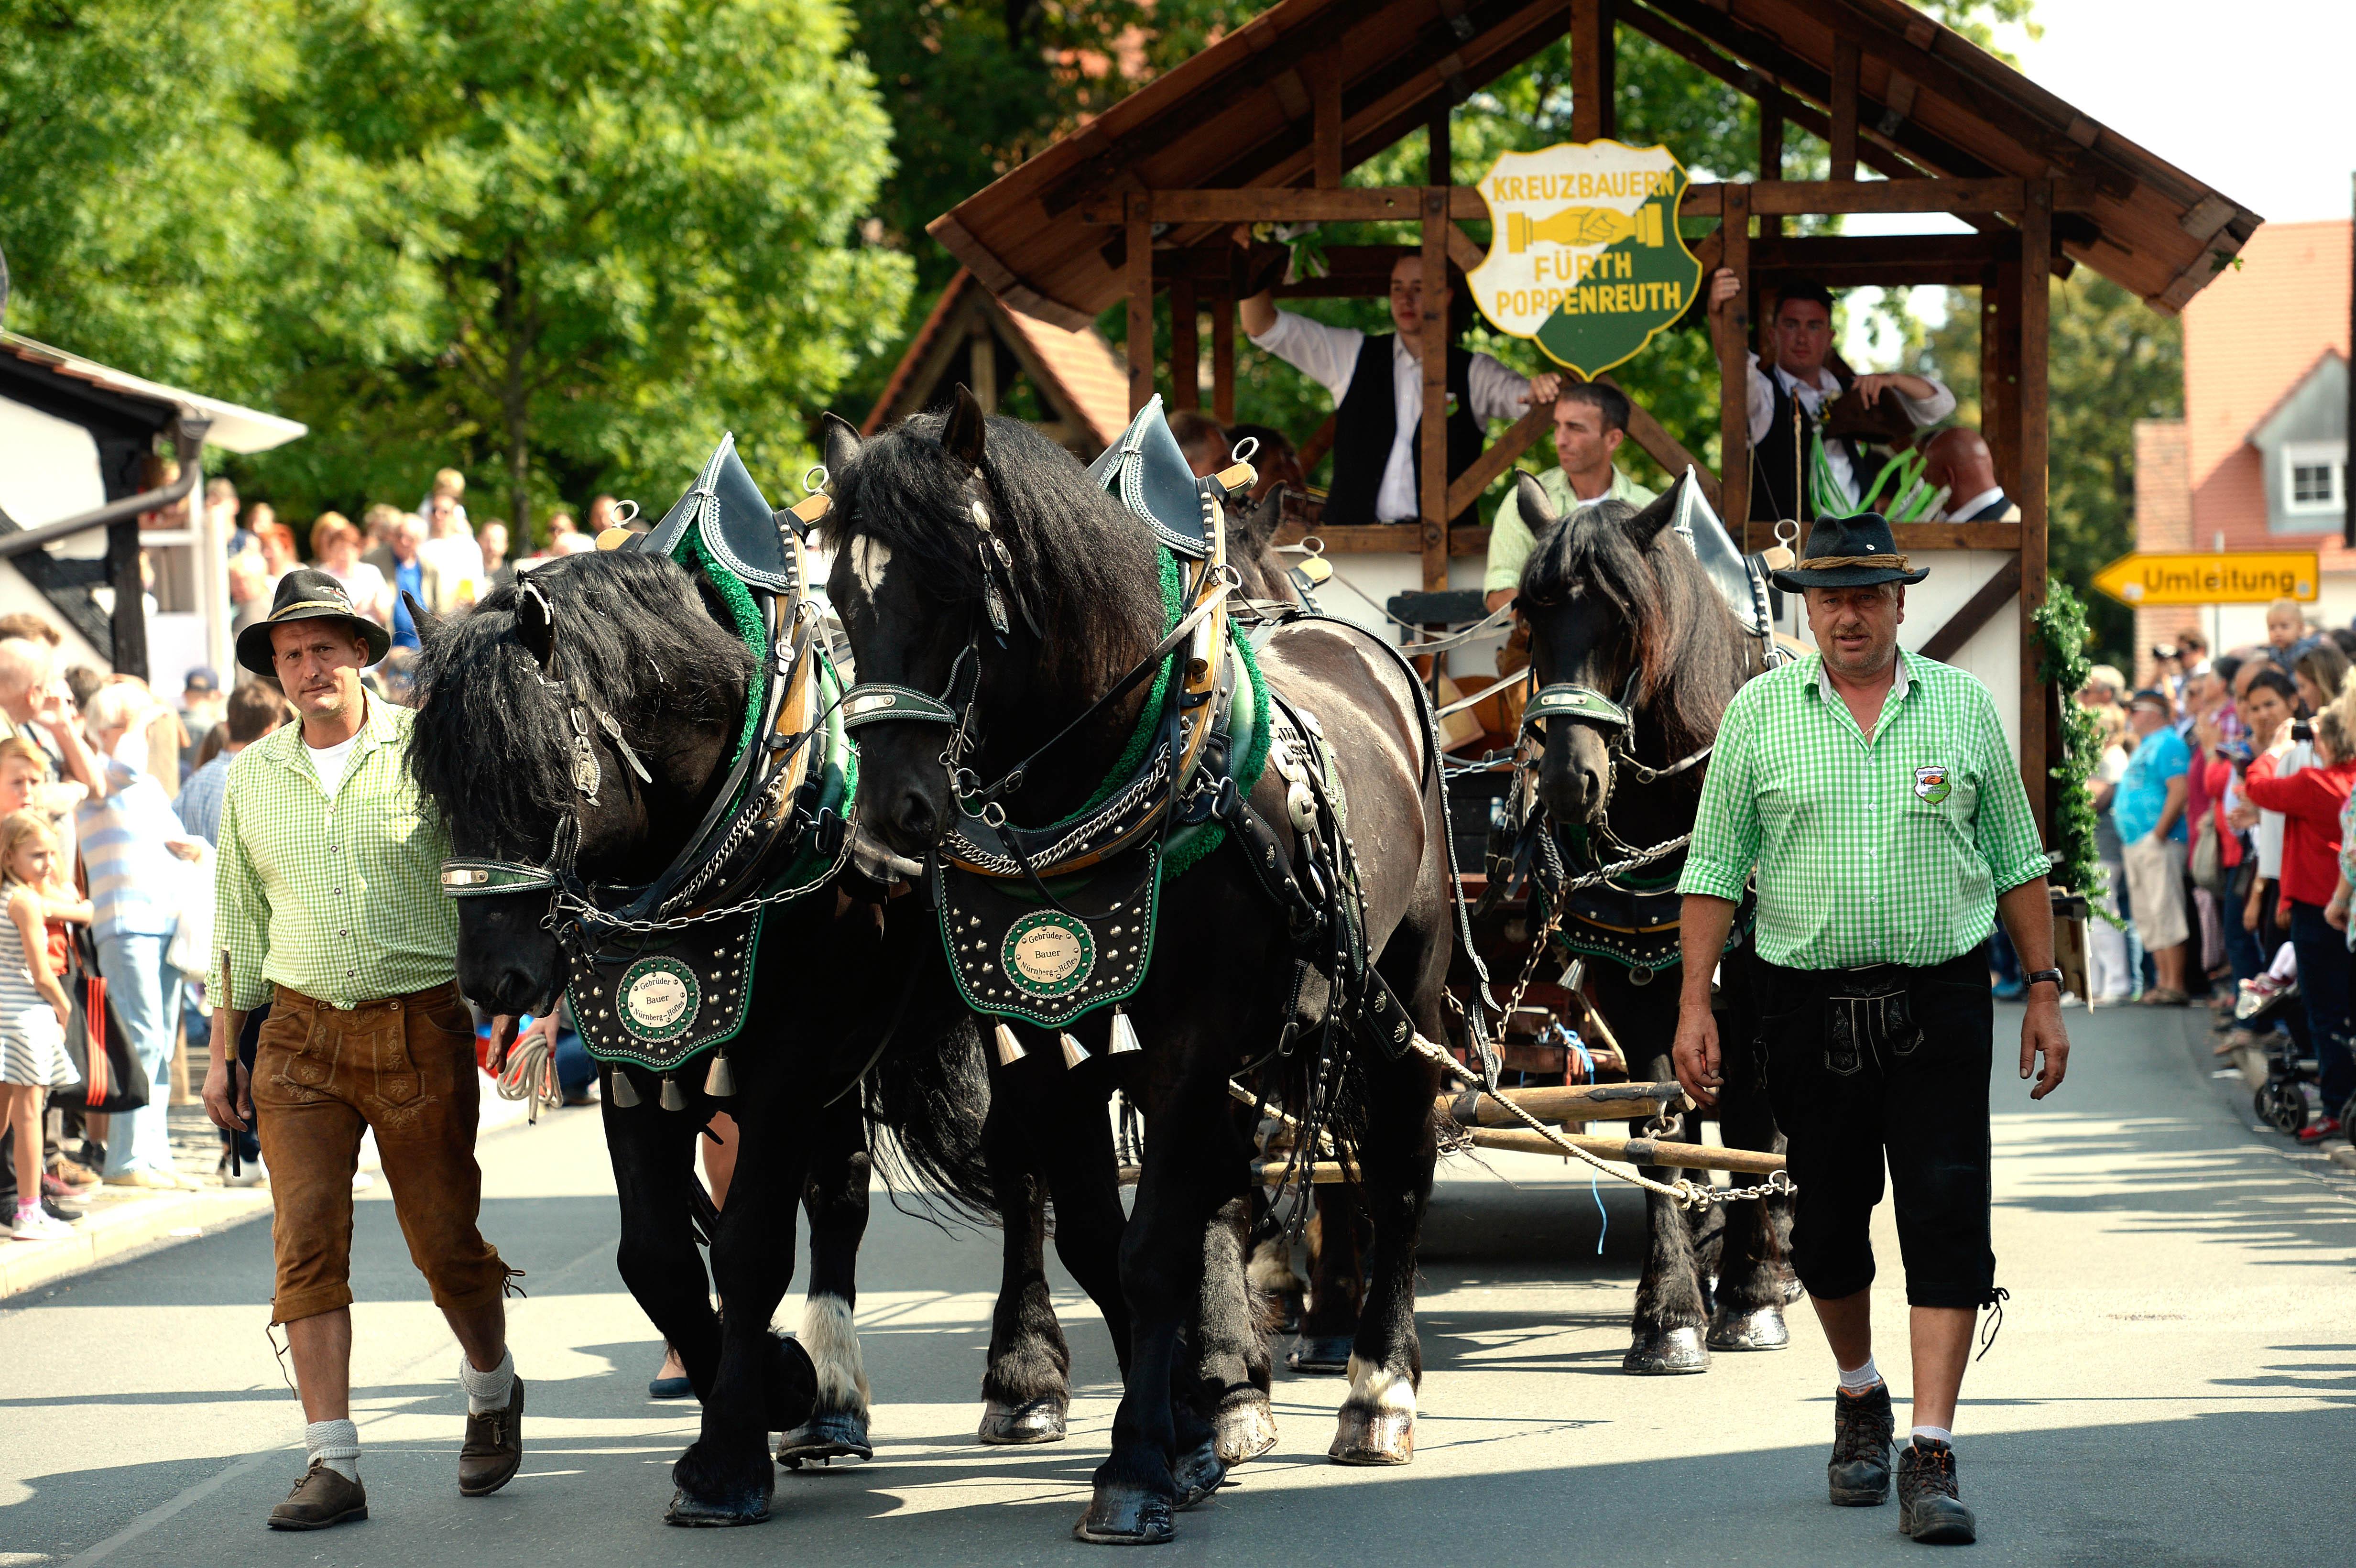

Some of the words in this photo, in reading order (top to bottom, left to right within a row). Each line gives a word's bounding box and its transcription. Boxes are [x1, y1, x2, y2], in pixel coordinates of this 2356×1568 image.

[1493, 170, 1674, 201] KREUZBAUERN
[1534, 250, 1633, 282] FÜRTH
[1496, 281, 1681, 317] POPPENREUTH
[2144, 566, 2295, 596] Umleitung
[1029, 932, 1063, 943] Gebrüder
[1035, 950, 1060, 958] Bauer
[640, 978, 670, 990] Gebrüder
[646, 995, 669, 1004] Bauer
